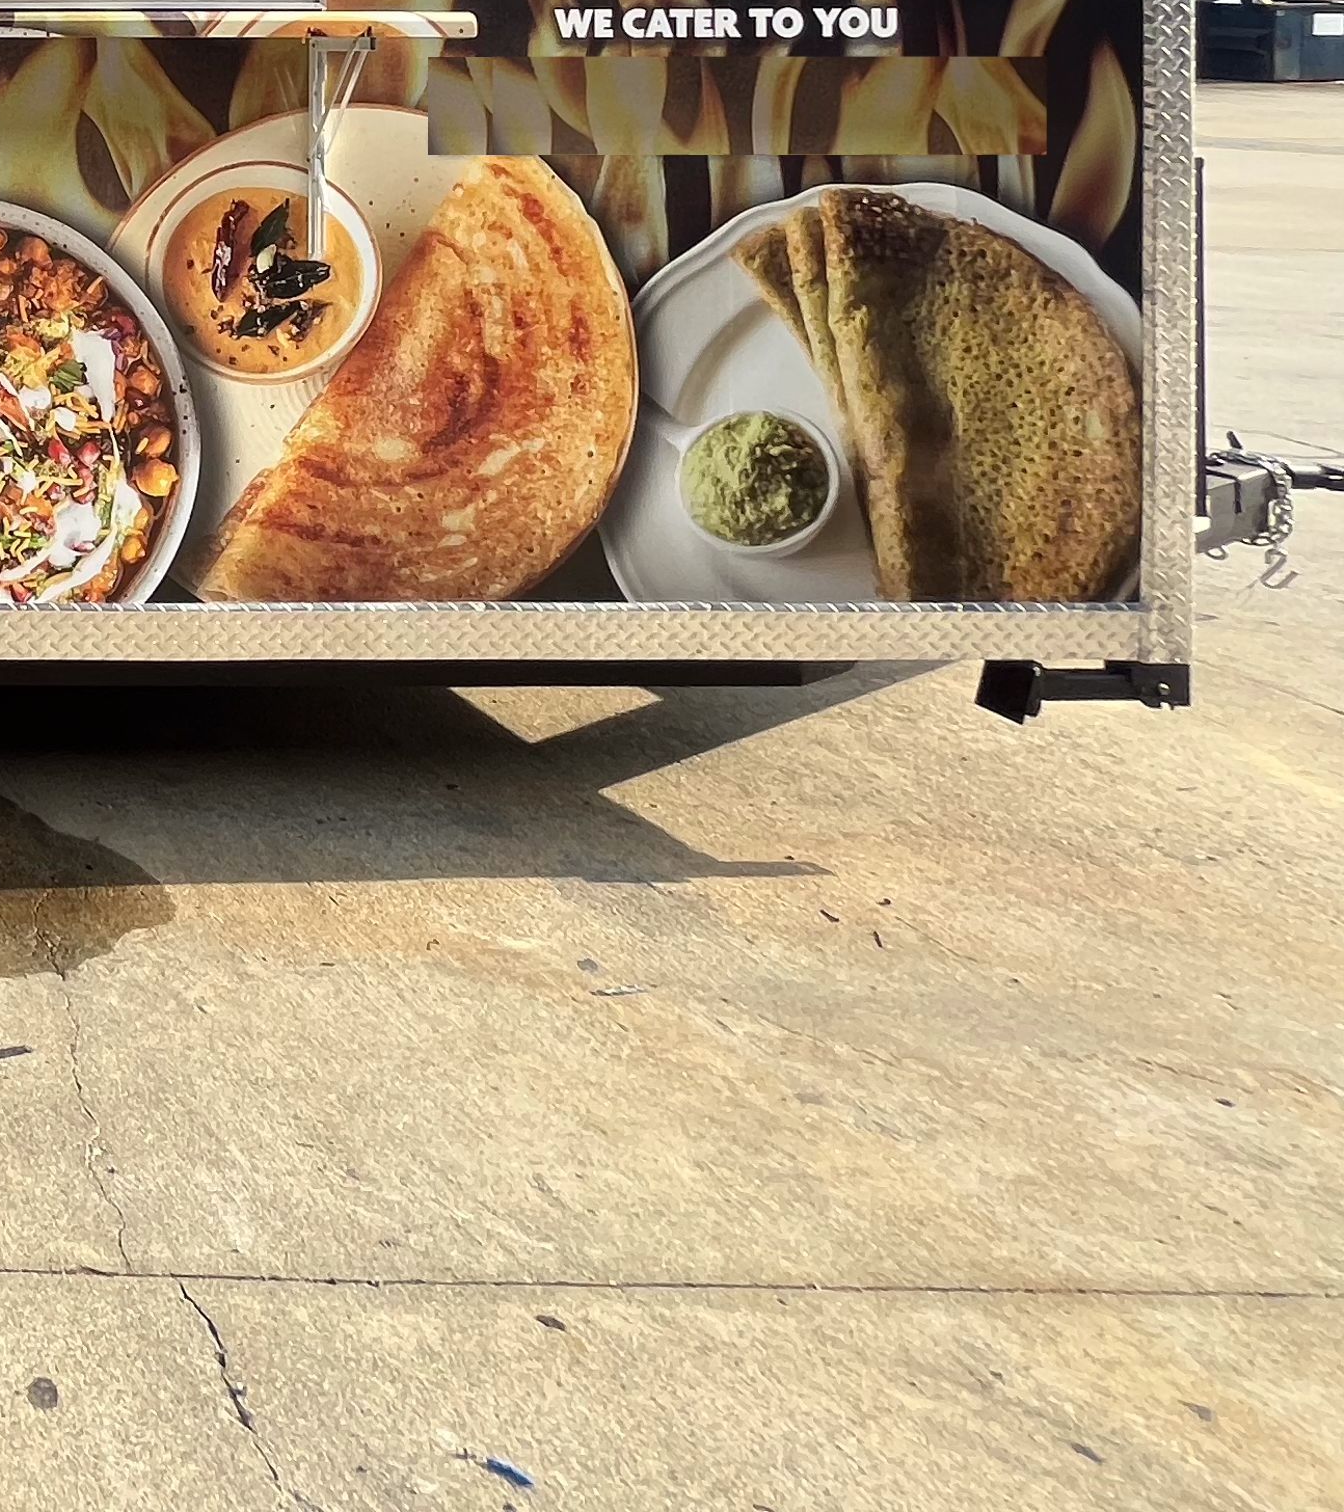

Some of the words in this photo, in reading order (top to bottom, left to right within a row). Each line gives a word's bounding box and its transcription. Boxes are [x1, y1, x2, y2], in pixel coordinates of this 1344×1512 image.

[554, 7, 615, 39] WE
[621, 7, 742, 39] CATER
[747, 7, 805, 38] TO
[812, 6, 900, 38] YOU
